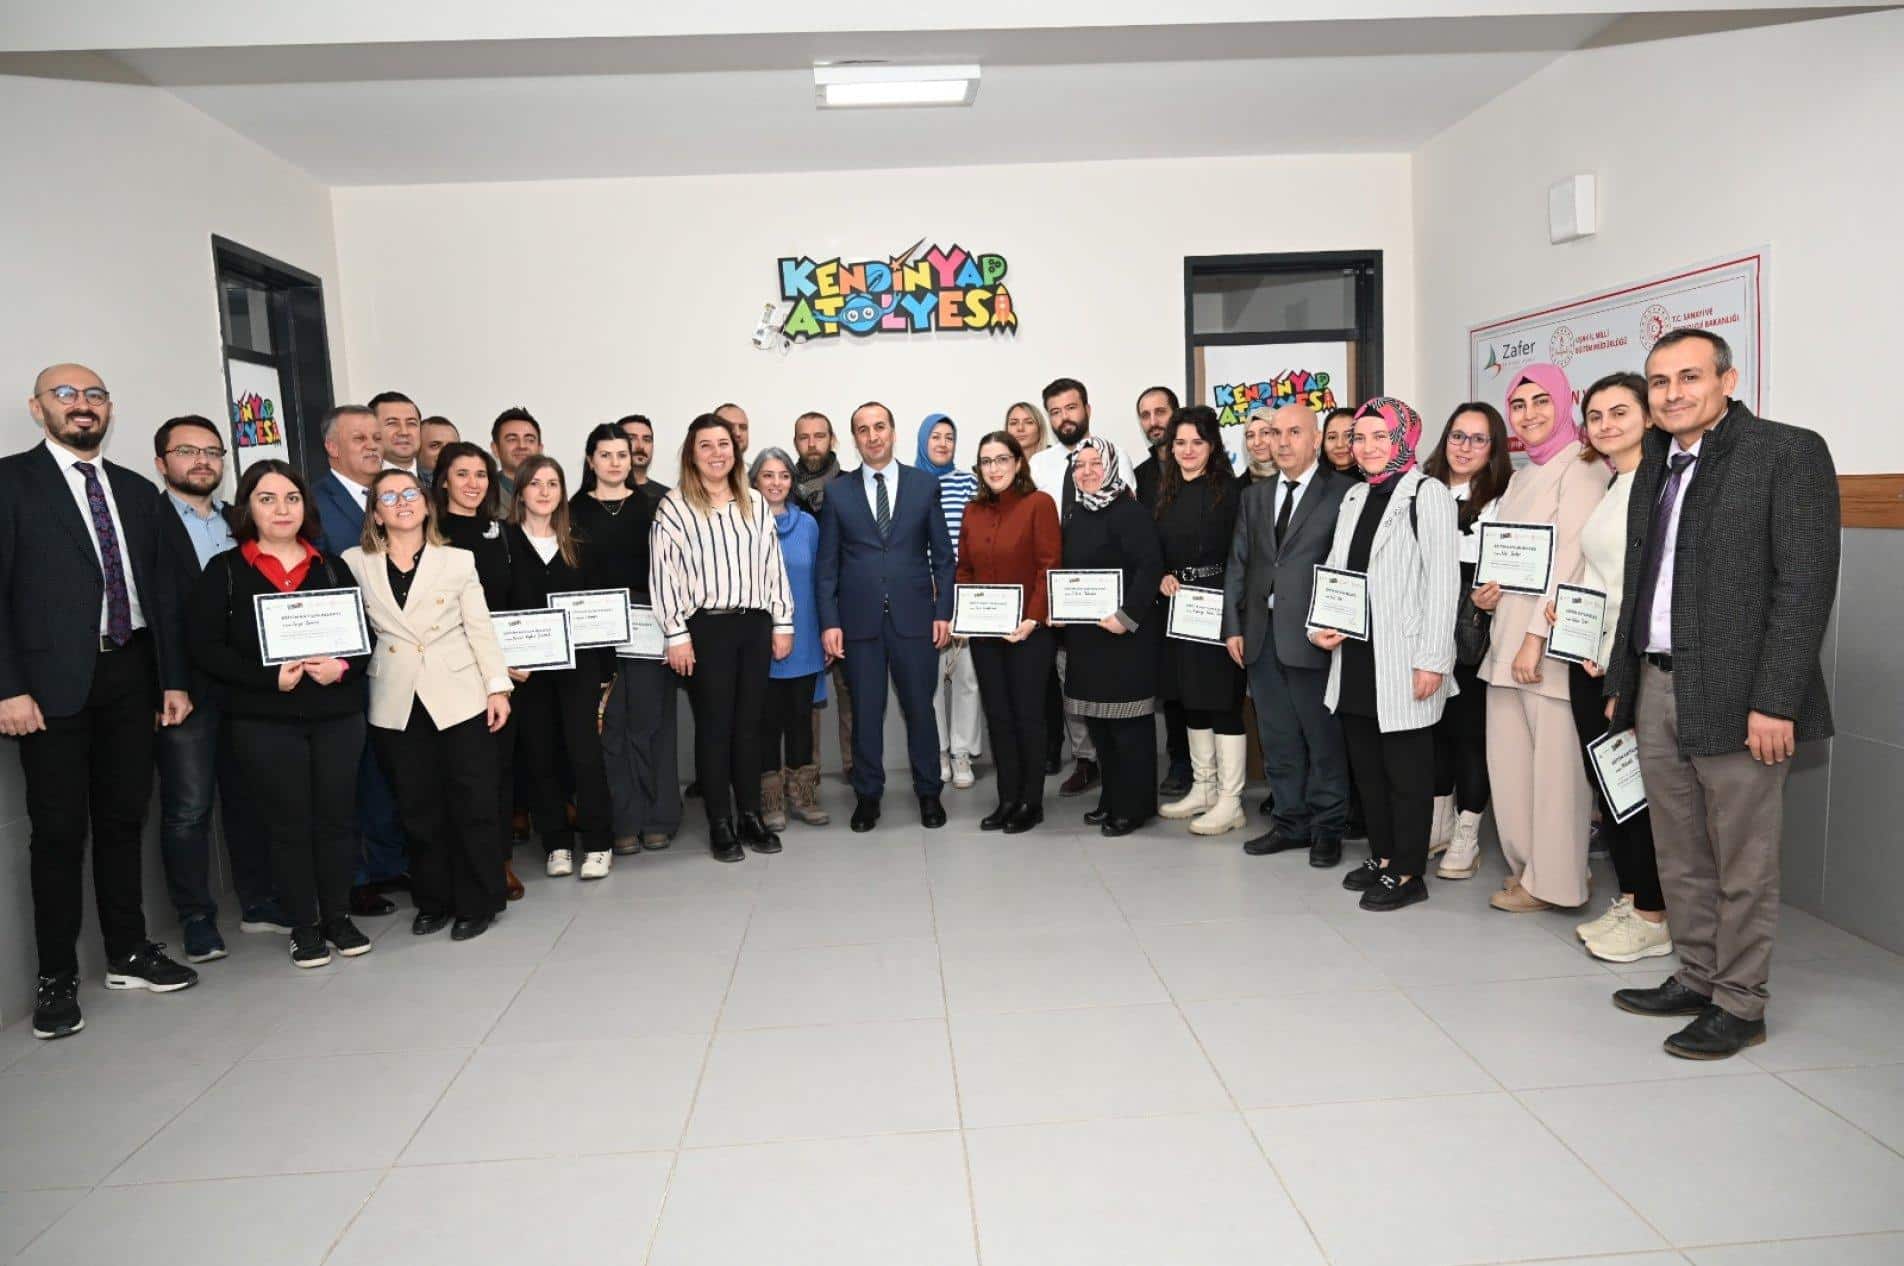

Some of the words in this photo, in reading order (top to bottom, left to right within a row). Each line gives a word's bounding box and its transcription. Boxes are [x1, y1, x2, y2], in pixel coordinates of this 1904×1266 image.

[926, 243, 1008, 288] YAP
[1502, 340, 1536, 359] Zafer
[1288, 369, 1330, 392] YAP
